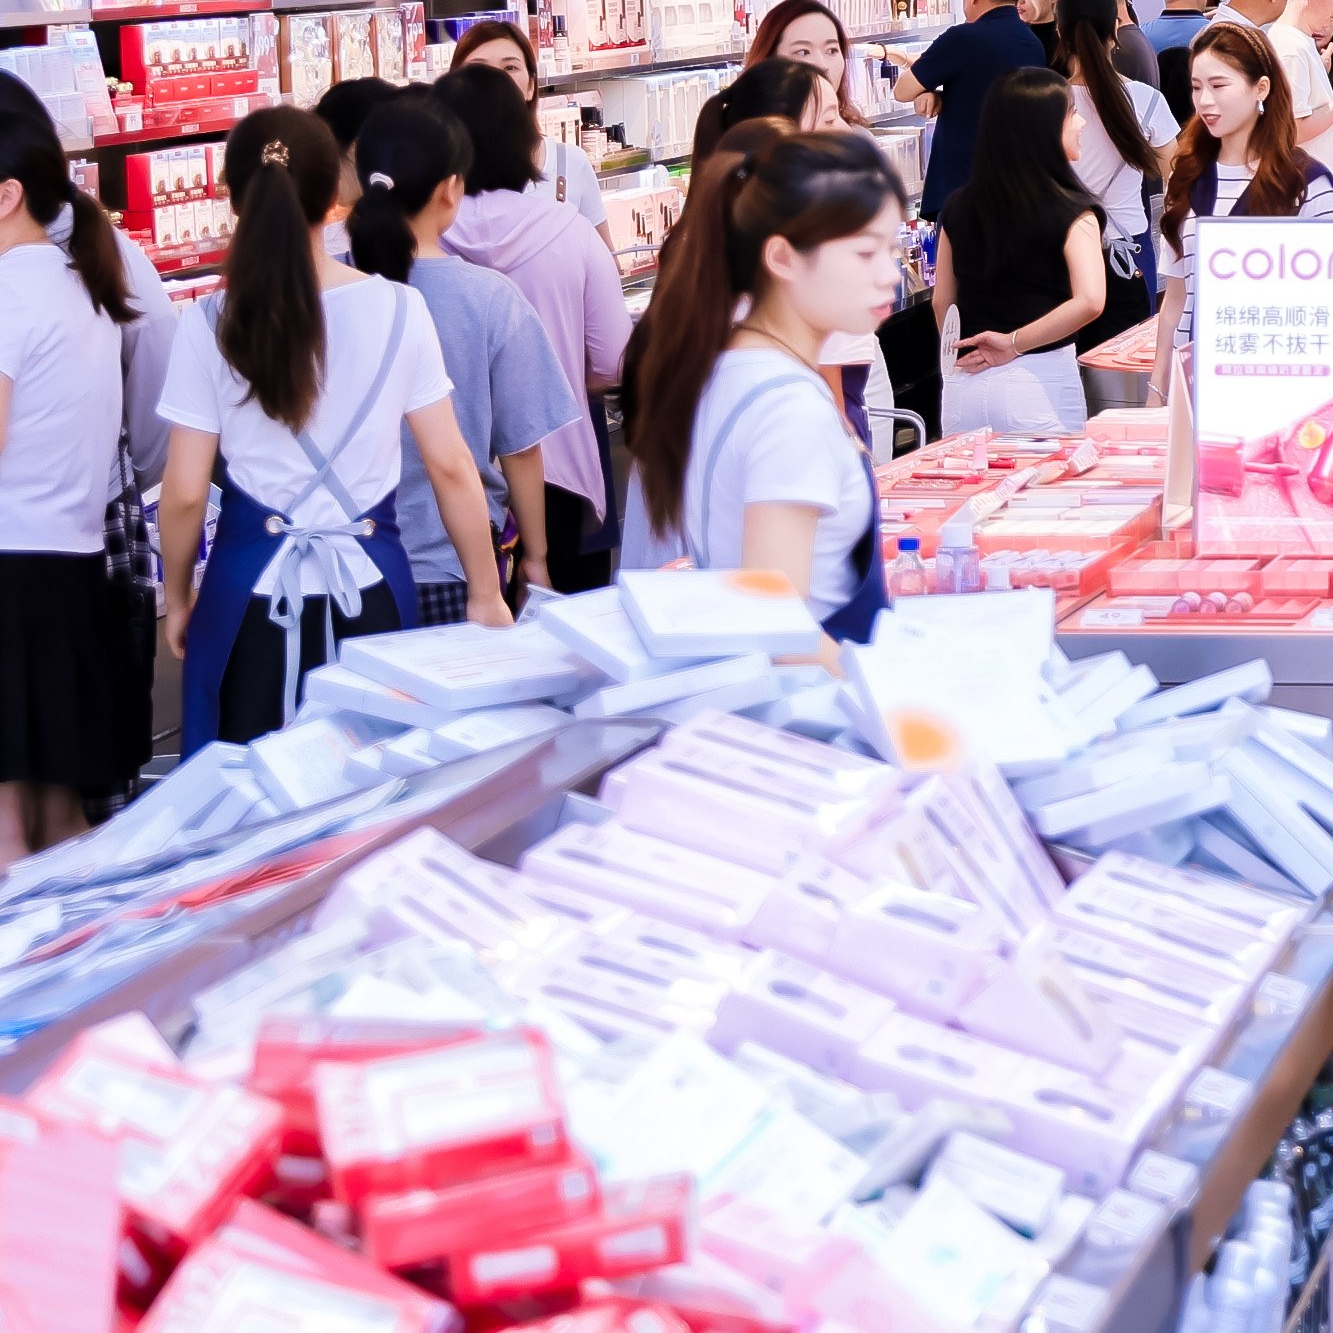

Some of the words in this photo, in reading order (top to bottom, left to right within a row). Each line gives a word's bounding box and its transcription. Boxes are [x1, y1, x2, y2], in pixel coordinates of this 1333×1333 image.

[1215, 304, 1331, 328] 绵绵高顺滑
[1215, 332, 1331, 356] 绒雾不拔干
